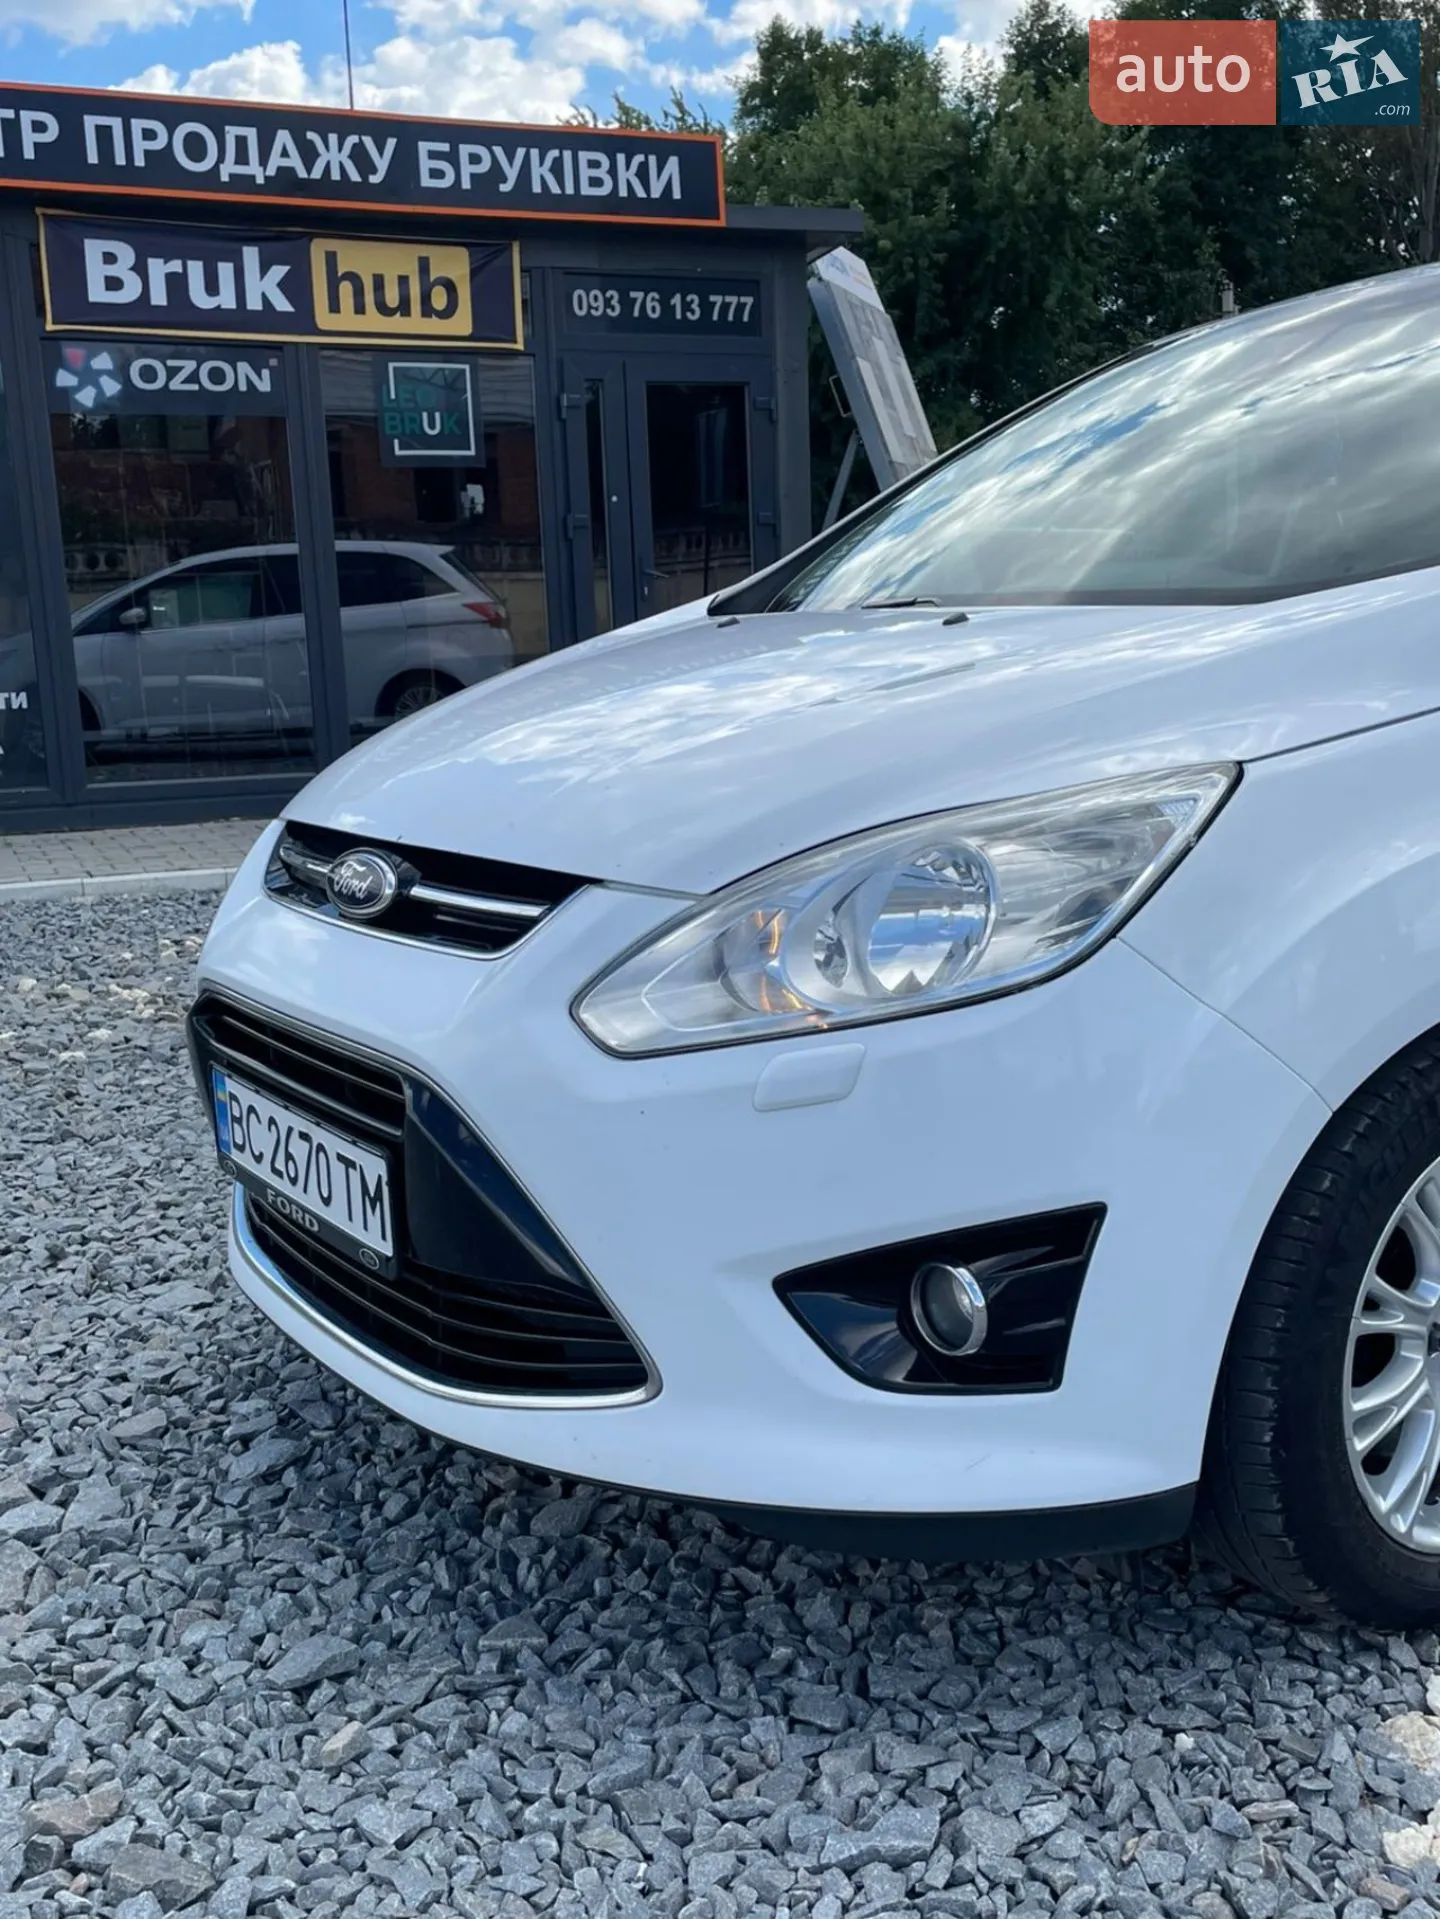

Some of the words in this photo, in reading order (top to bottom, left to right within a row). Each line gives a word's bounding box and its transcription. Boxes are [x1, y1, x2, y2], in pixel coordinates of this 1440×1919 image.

[83, 114, 397, 184] ПРОДАЖУ
[417, 141, 682, 199] БРУКІВКИ
[84, 238, 295, 312] Bruk
[324, 250, 459, 320] hub
[573, 289, 621, 317] 093
[629, 291, 661, 319] 76
[670, 293, 701, 321] 13
[709, 295, 754, 322] 777
[130, 358, 271, 392] OZON
[384, 411, 462, 436] BRUK
[333, 861, 373, 899] Ford
[266, 1188, 319, 1232] FORD
